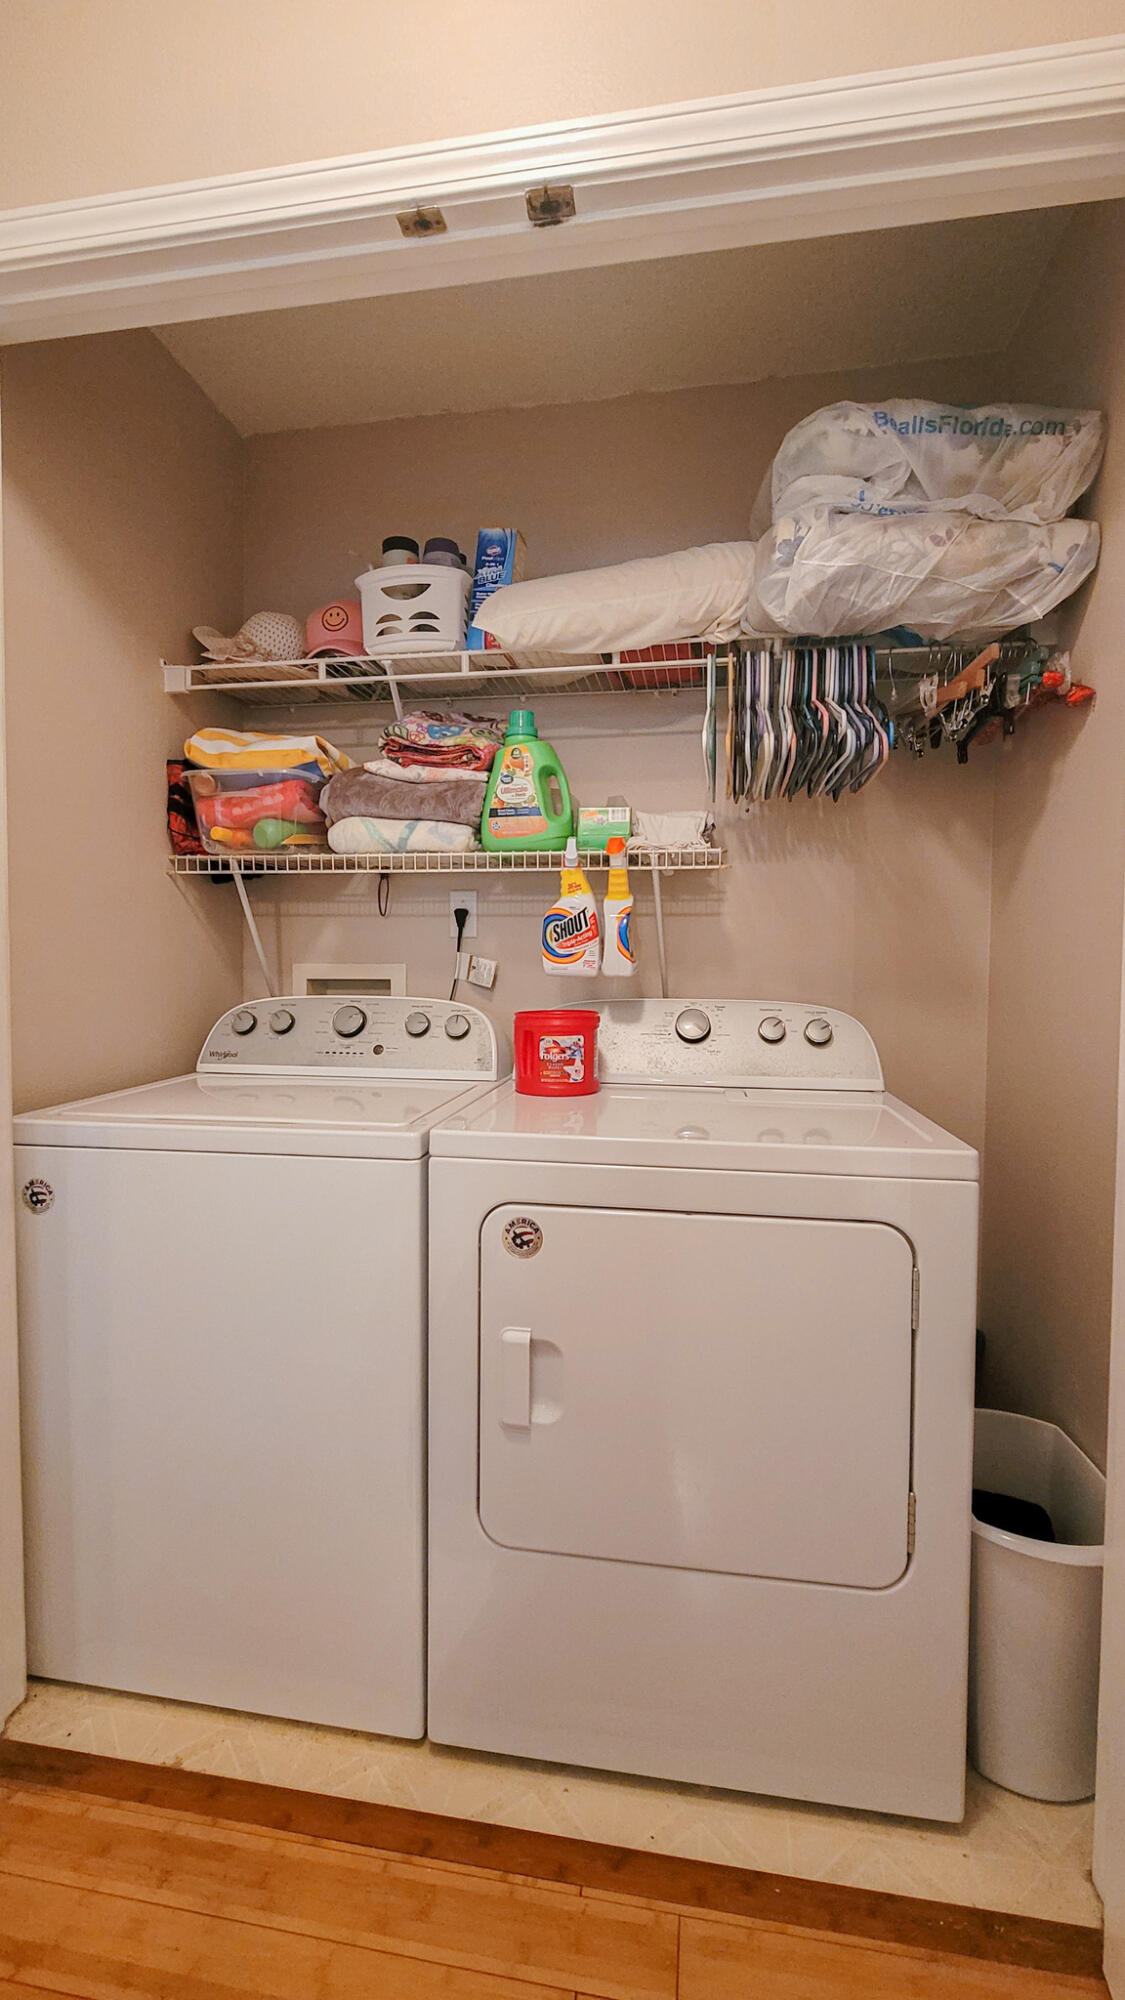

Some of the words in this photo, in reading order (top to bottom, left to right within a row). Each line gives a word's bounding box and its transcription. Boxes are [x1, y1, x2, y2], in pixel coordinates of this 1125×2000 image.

[478, 570, 506, 584] BLUE
[552, 907, 588, 942] SHOUT
[25, 1179, 53, 1196] AMERICA
[505, 1217, 540, 1235] AMERICA
